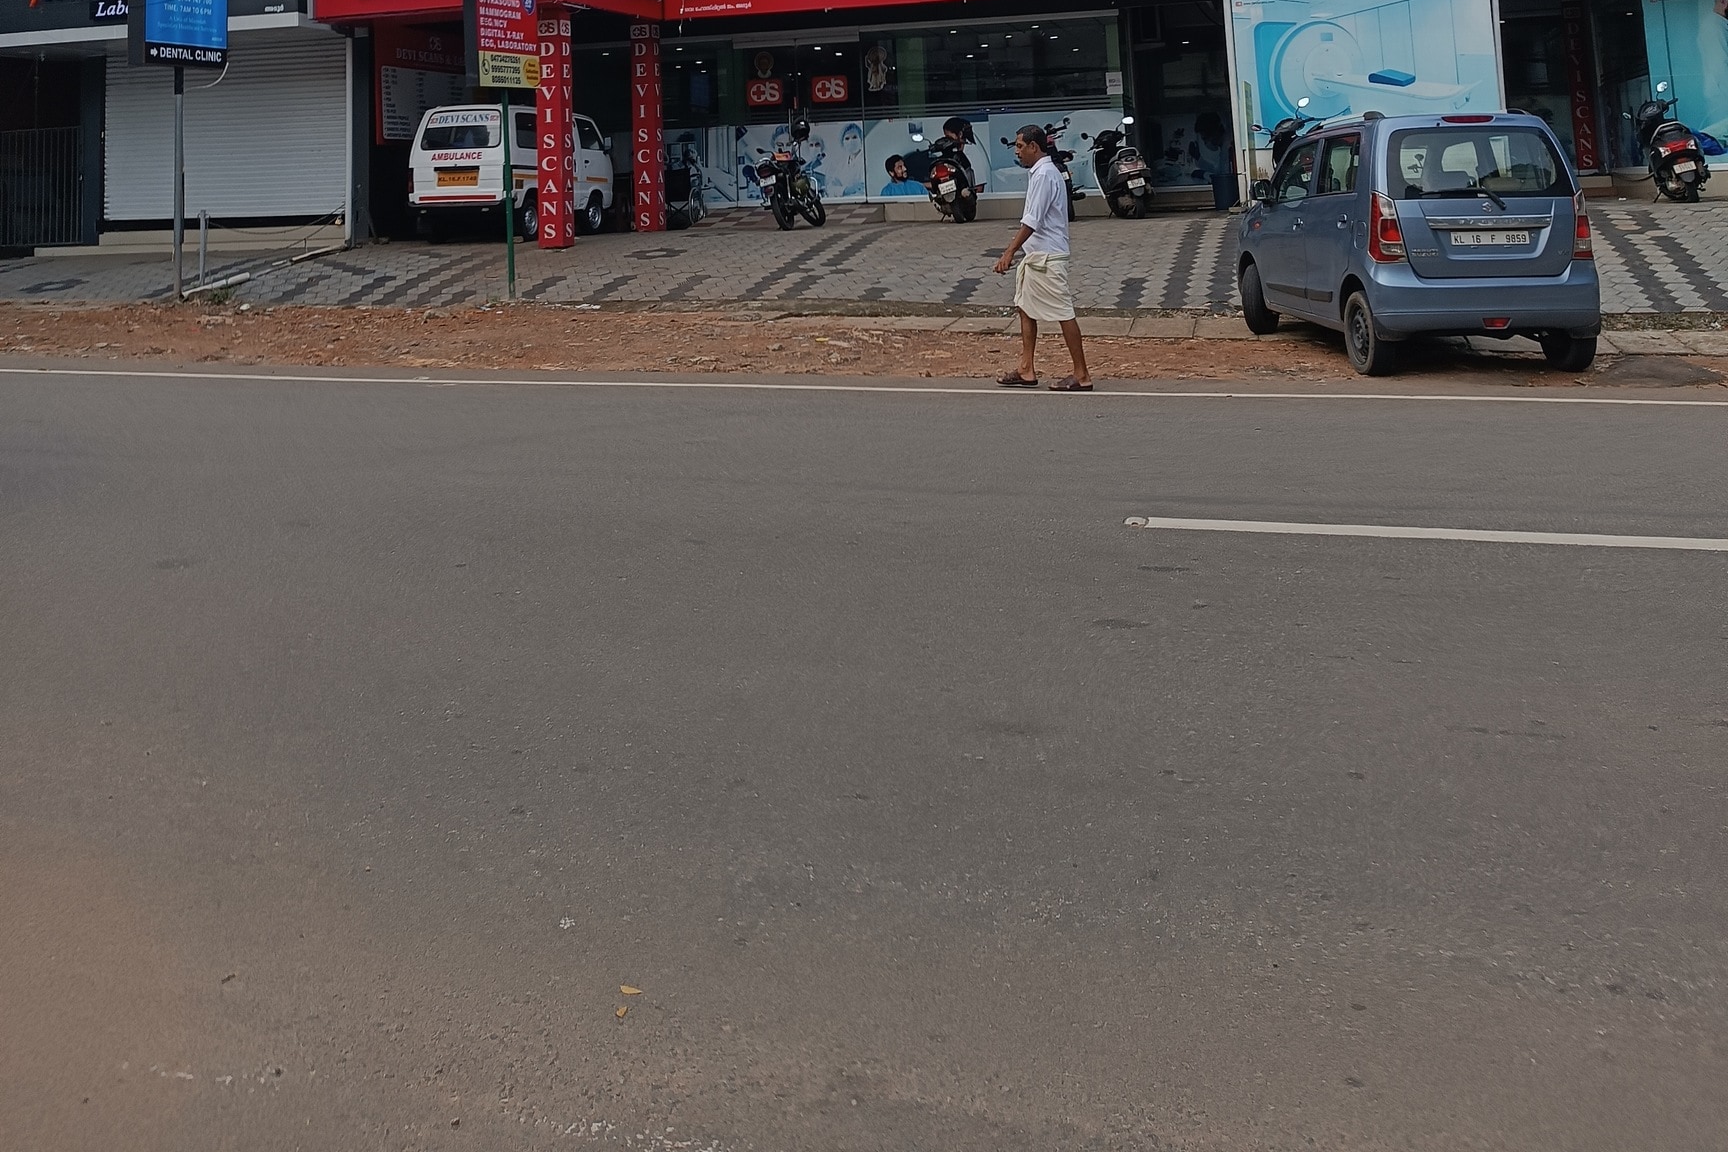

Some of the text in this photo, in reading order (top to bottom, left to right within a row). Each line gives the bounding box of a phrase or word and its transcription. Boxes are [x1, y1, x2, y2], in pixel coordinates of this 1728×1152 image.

[479, 6, 521, 20] MAMMOGRAM
[480, 28, 506, 38] DIGITAL
[497, 40, 537, 52] LABORATORY
[160, 47, 222, 63] DENTAL CLINIC
[438, 115, 459, 124] DEVI
[460, 113, 490, 123] SCANS
[431, 152, 483, 161] AMBULANCE
[1454, 234, 1526, 243] KL 16 F 9859
